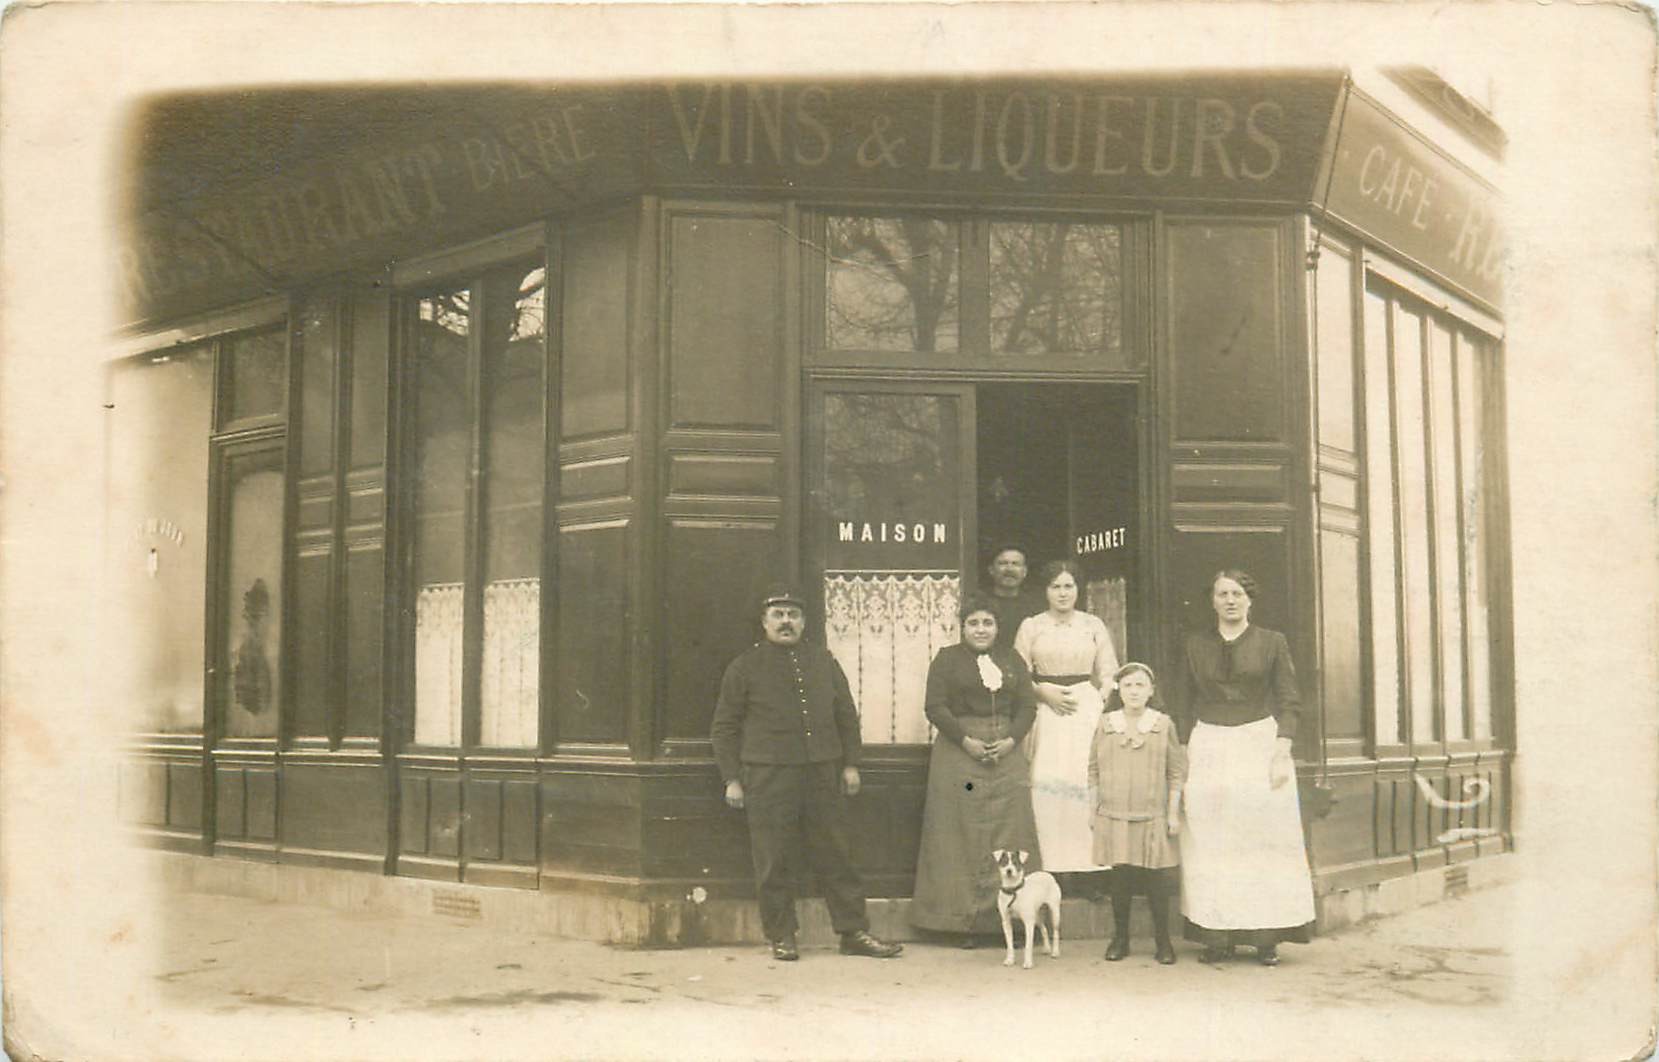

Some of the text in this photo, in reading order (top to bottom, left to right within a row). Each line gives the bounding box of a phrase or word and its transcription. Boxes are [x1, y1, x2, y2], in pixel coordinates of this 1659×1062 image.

[665, 82, 1284, 183] VINS & LIQUEURS
[838, 521, 947, 543] MAISON
[1076, 527, 1126, 555] CABARET
